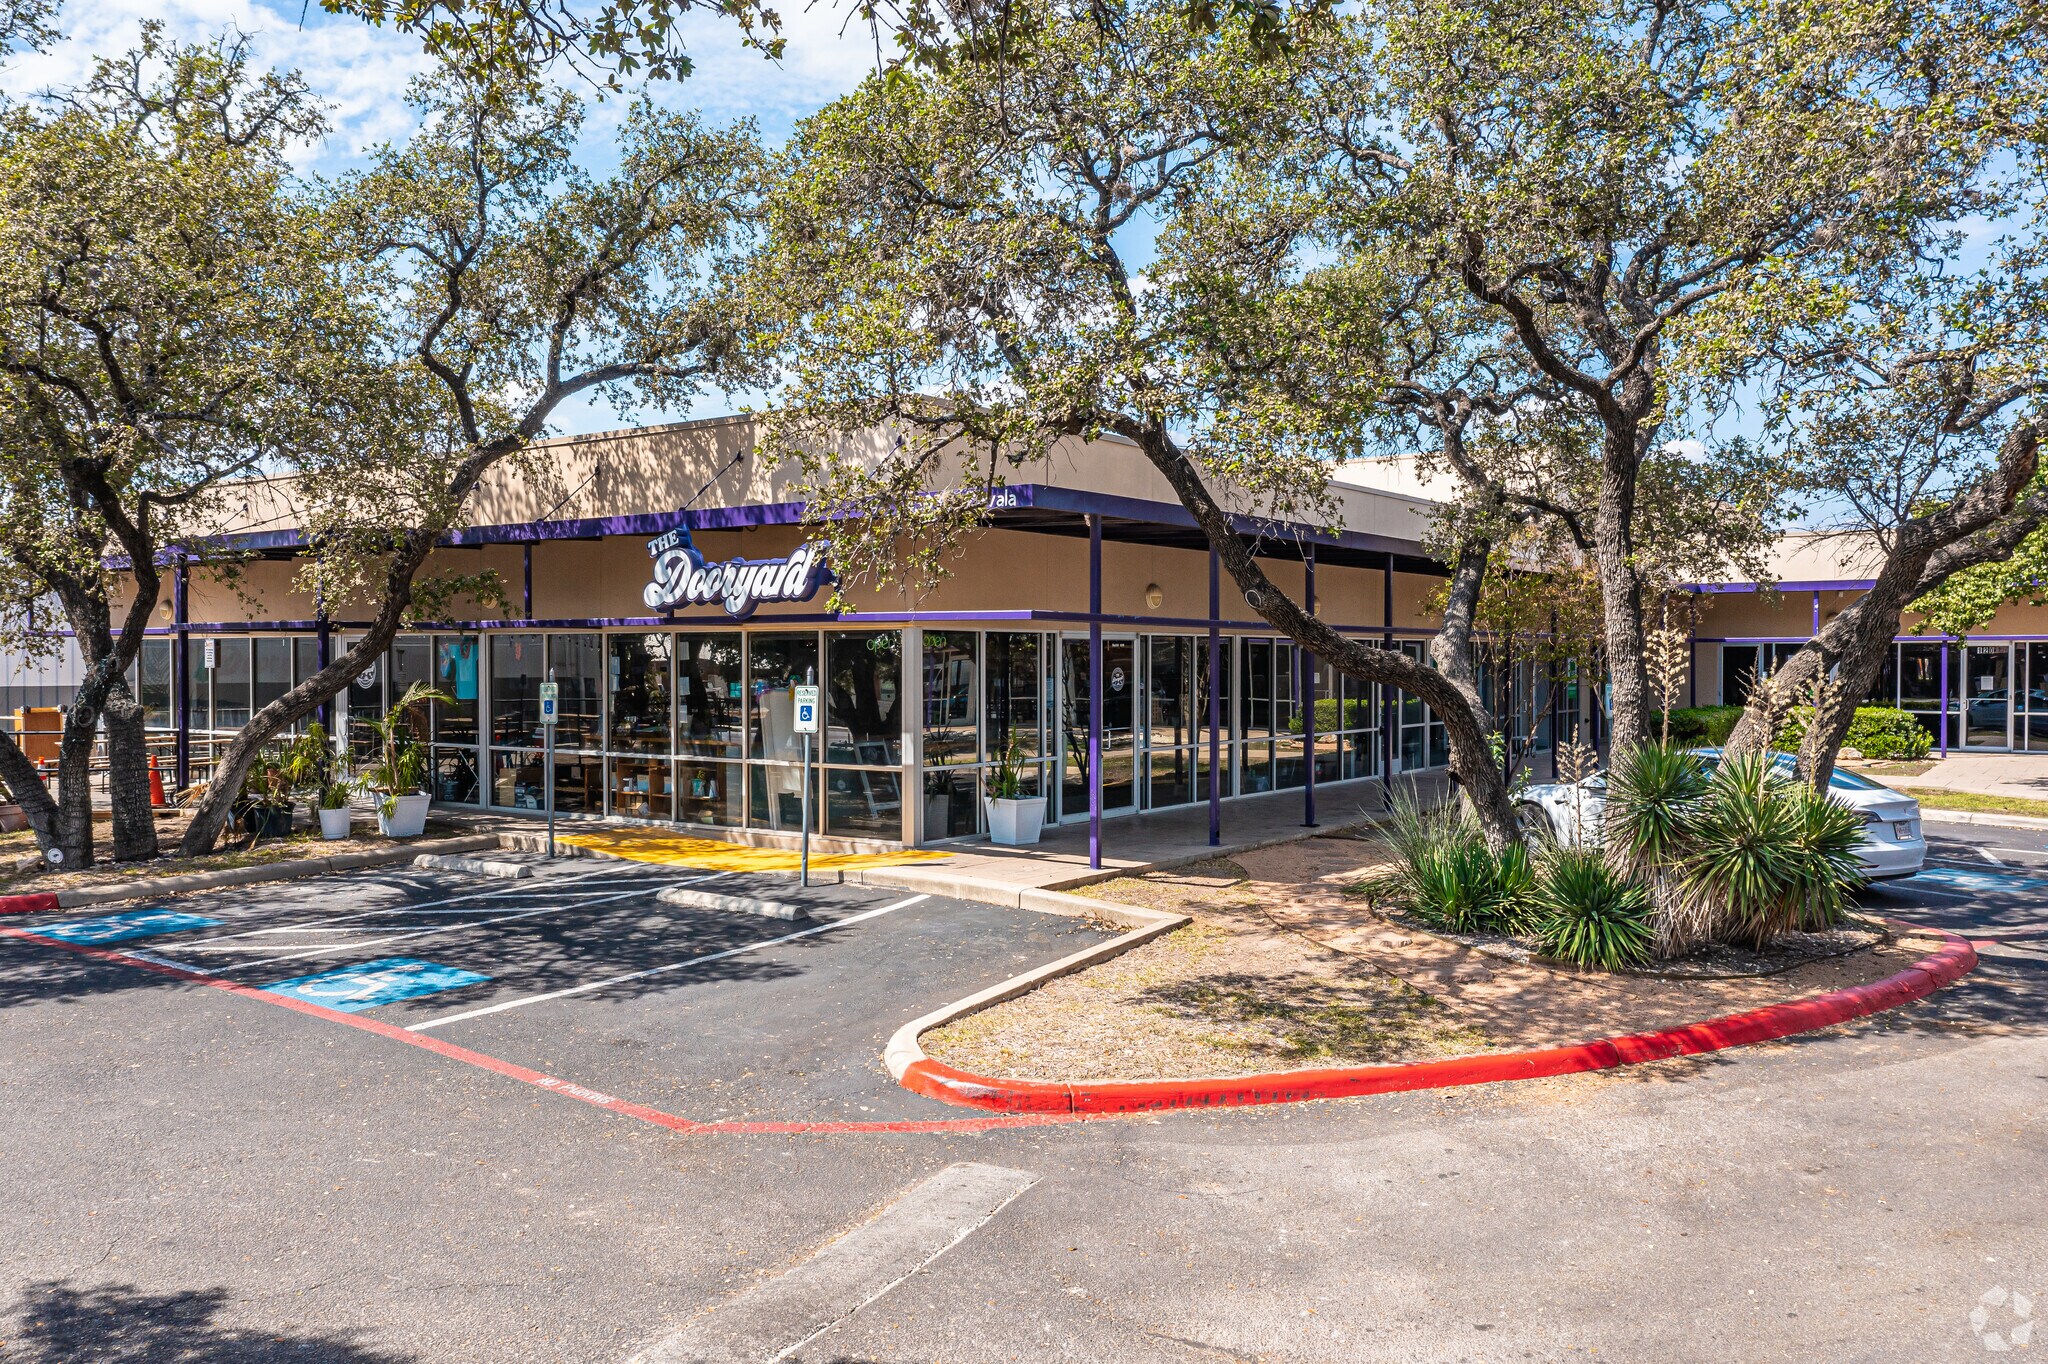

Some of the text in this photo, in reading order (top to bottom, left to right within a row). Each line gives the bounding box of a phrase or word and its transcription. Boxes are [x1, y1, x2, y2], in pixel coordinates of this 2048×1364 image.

[647, 529, 680, 558] THE
[643, 547, 818, 615] Dooryard
[797, 697, 816, 705] PARKING
[534, 1077, 617, 1104] NO PARKING
